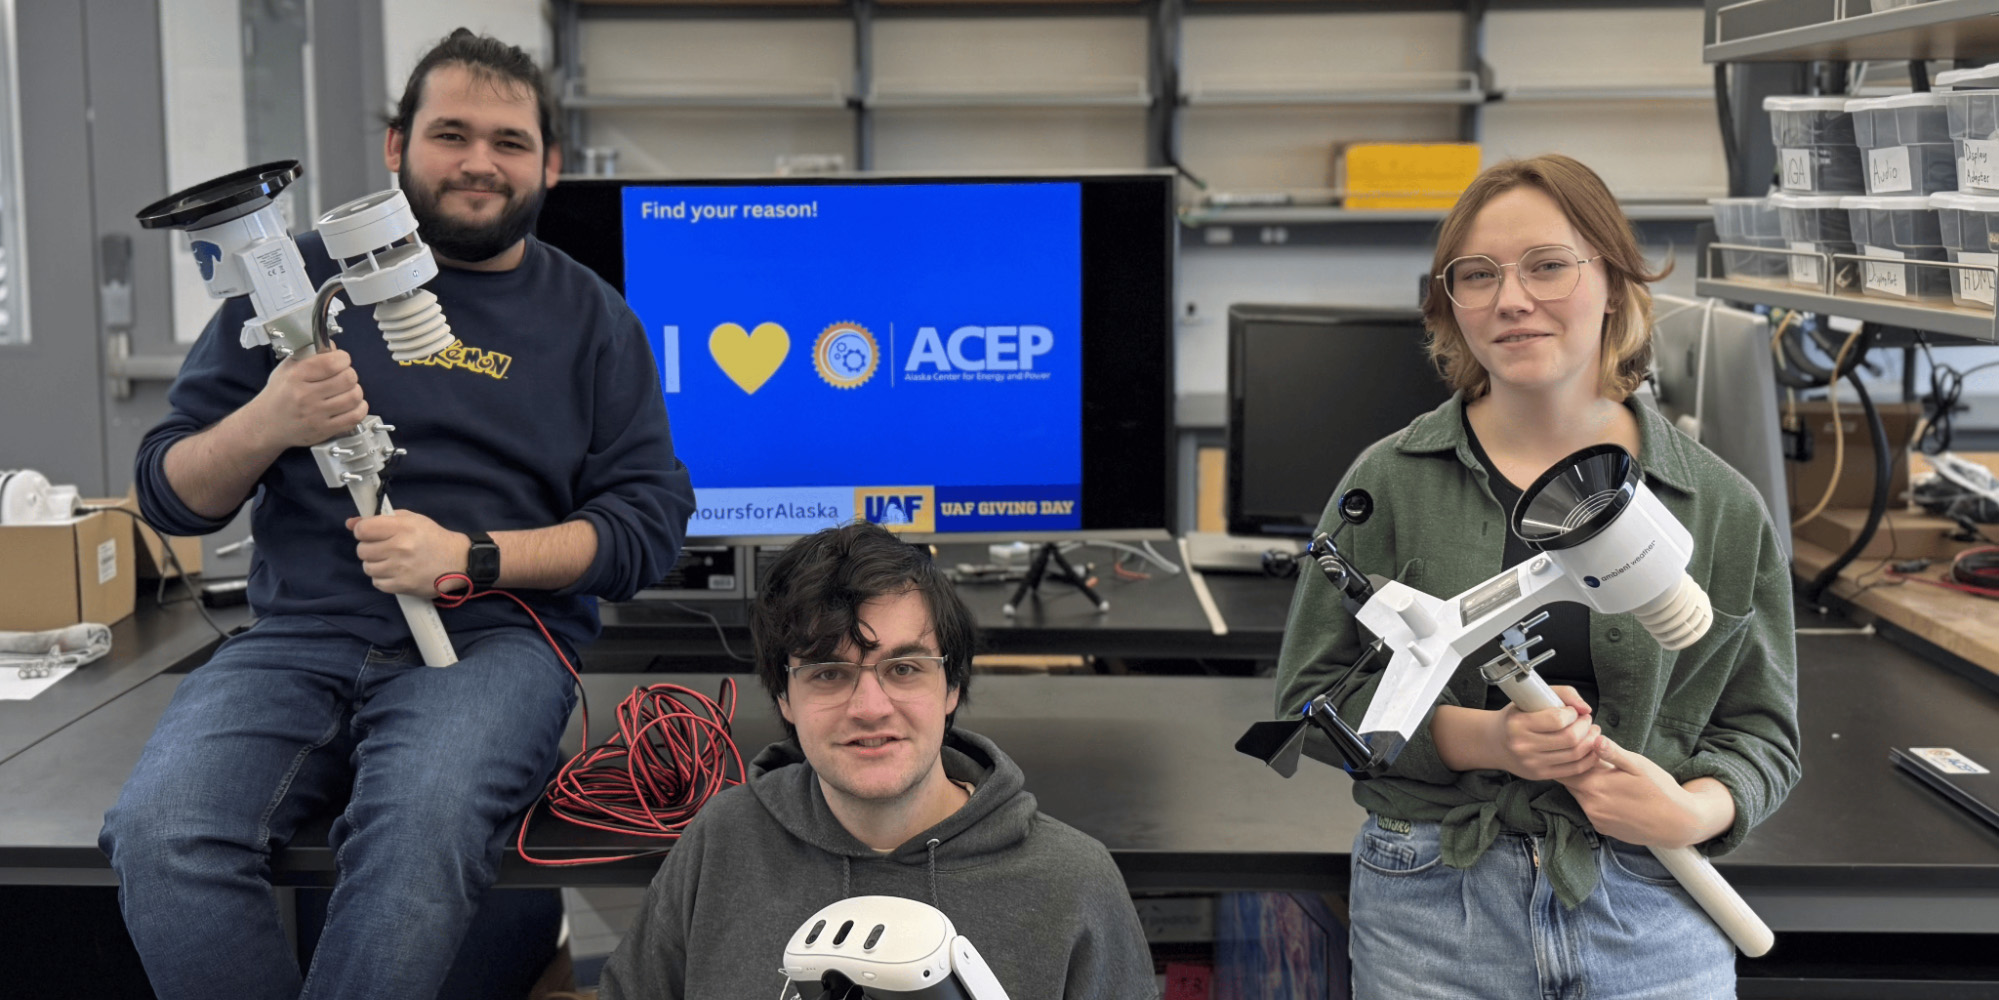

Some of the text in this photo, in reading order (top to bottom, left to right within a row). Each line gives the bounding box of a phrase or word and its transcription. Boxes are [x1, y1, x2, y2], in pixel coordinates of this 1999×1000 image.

[1965, 143, 1987, 165] Display
[1785, 156, 1806, 185] VGA
[1873, 158, 1898, 186] Audio
[1967, 169, 1990, 185] Adapter
[641, 201, 818, 223] Find your reason!
[664, 325, 1054, 393] I ACEP
[904, 371, 1051, 382] Alaska Center for Energy and Power
[864, 495, 923, 524] UAF
[940, 501, 1074, 516] UAF GIVING DAY
[1600, 563, 1631, 582] ambient
